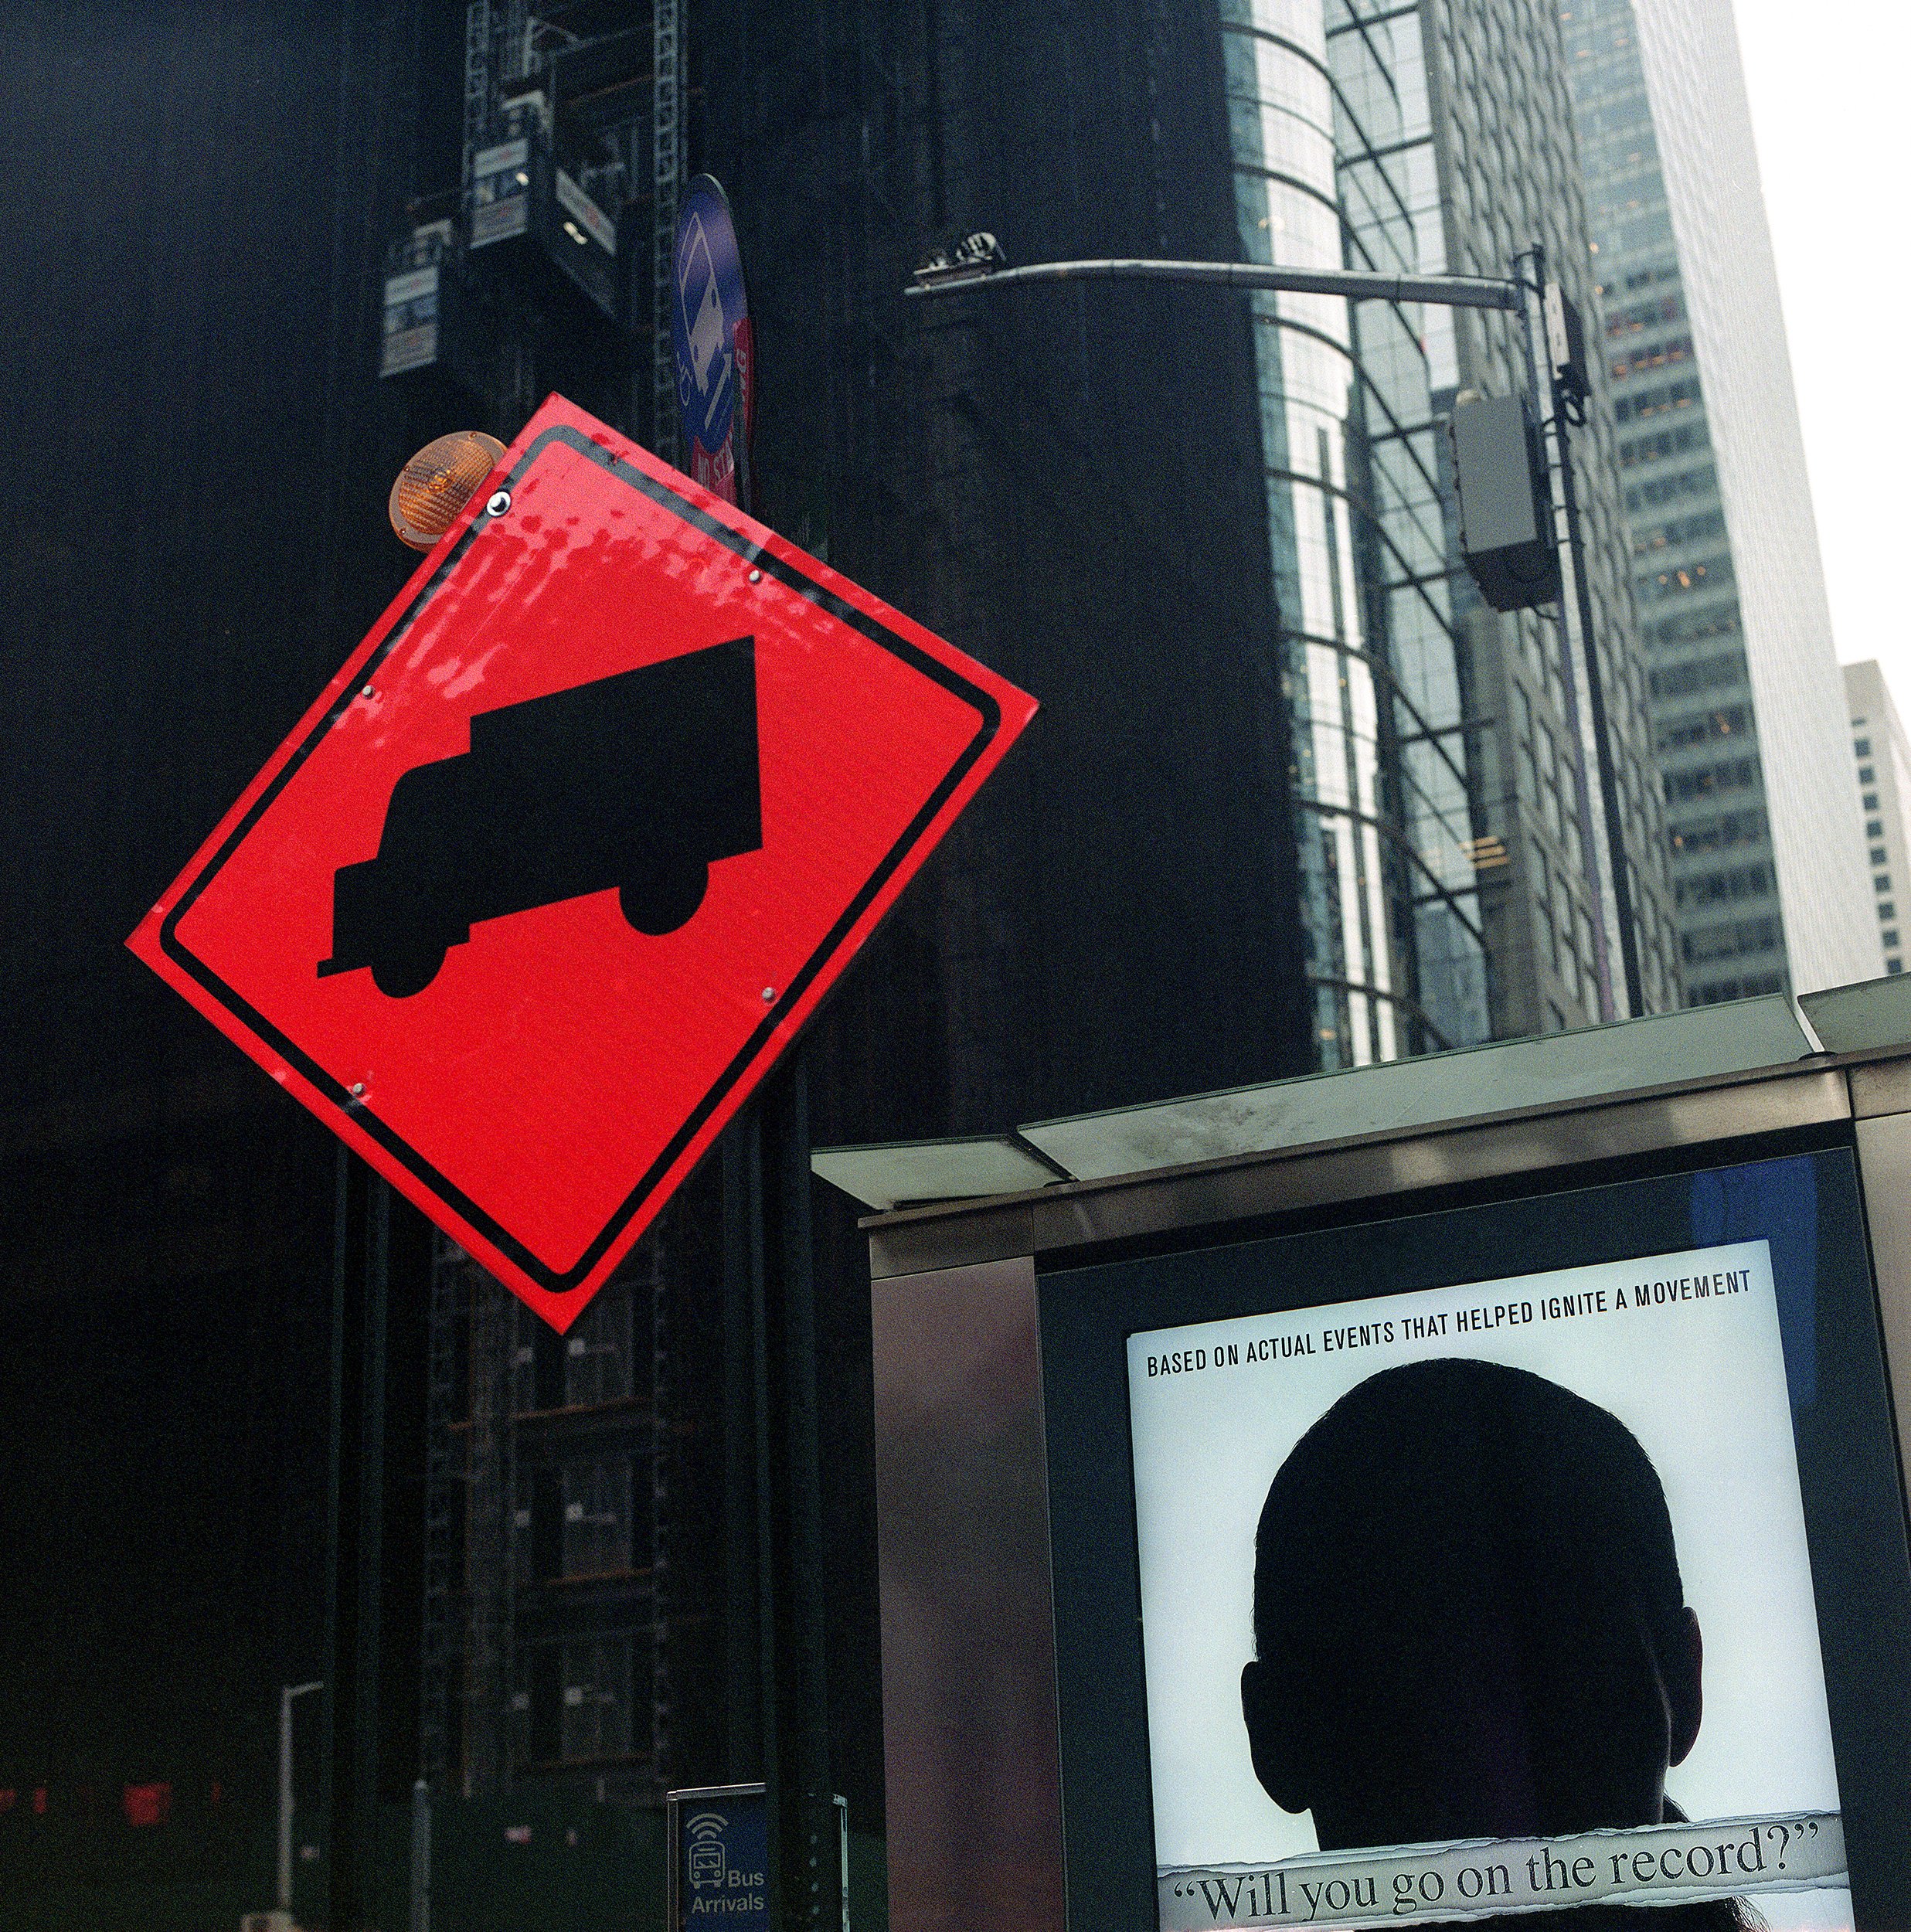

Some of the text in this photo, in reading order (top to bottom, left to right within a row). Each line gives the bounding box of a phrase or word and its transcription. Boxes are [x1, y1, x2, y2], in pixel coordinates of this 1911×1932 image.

[1147, 1269, 1750, 1377] BASED ON ACTUAL EVENTS THAT HELPED IGNITE A MOVEMENT
[728, 1869, 764, 1888] Bus
[1174, 1821, 1819, 1922] “Will you go on the record?”
[691, 1893, 764, 1914] Arrivals
